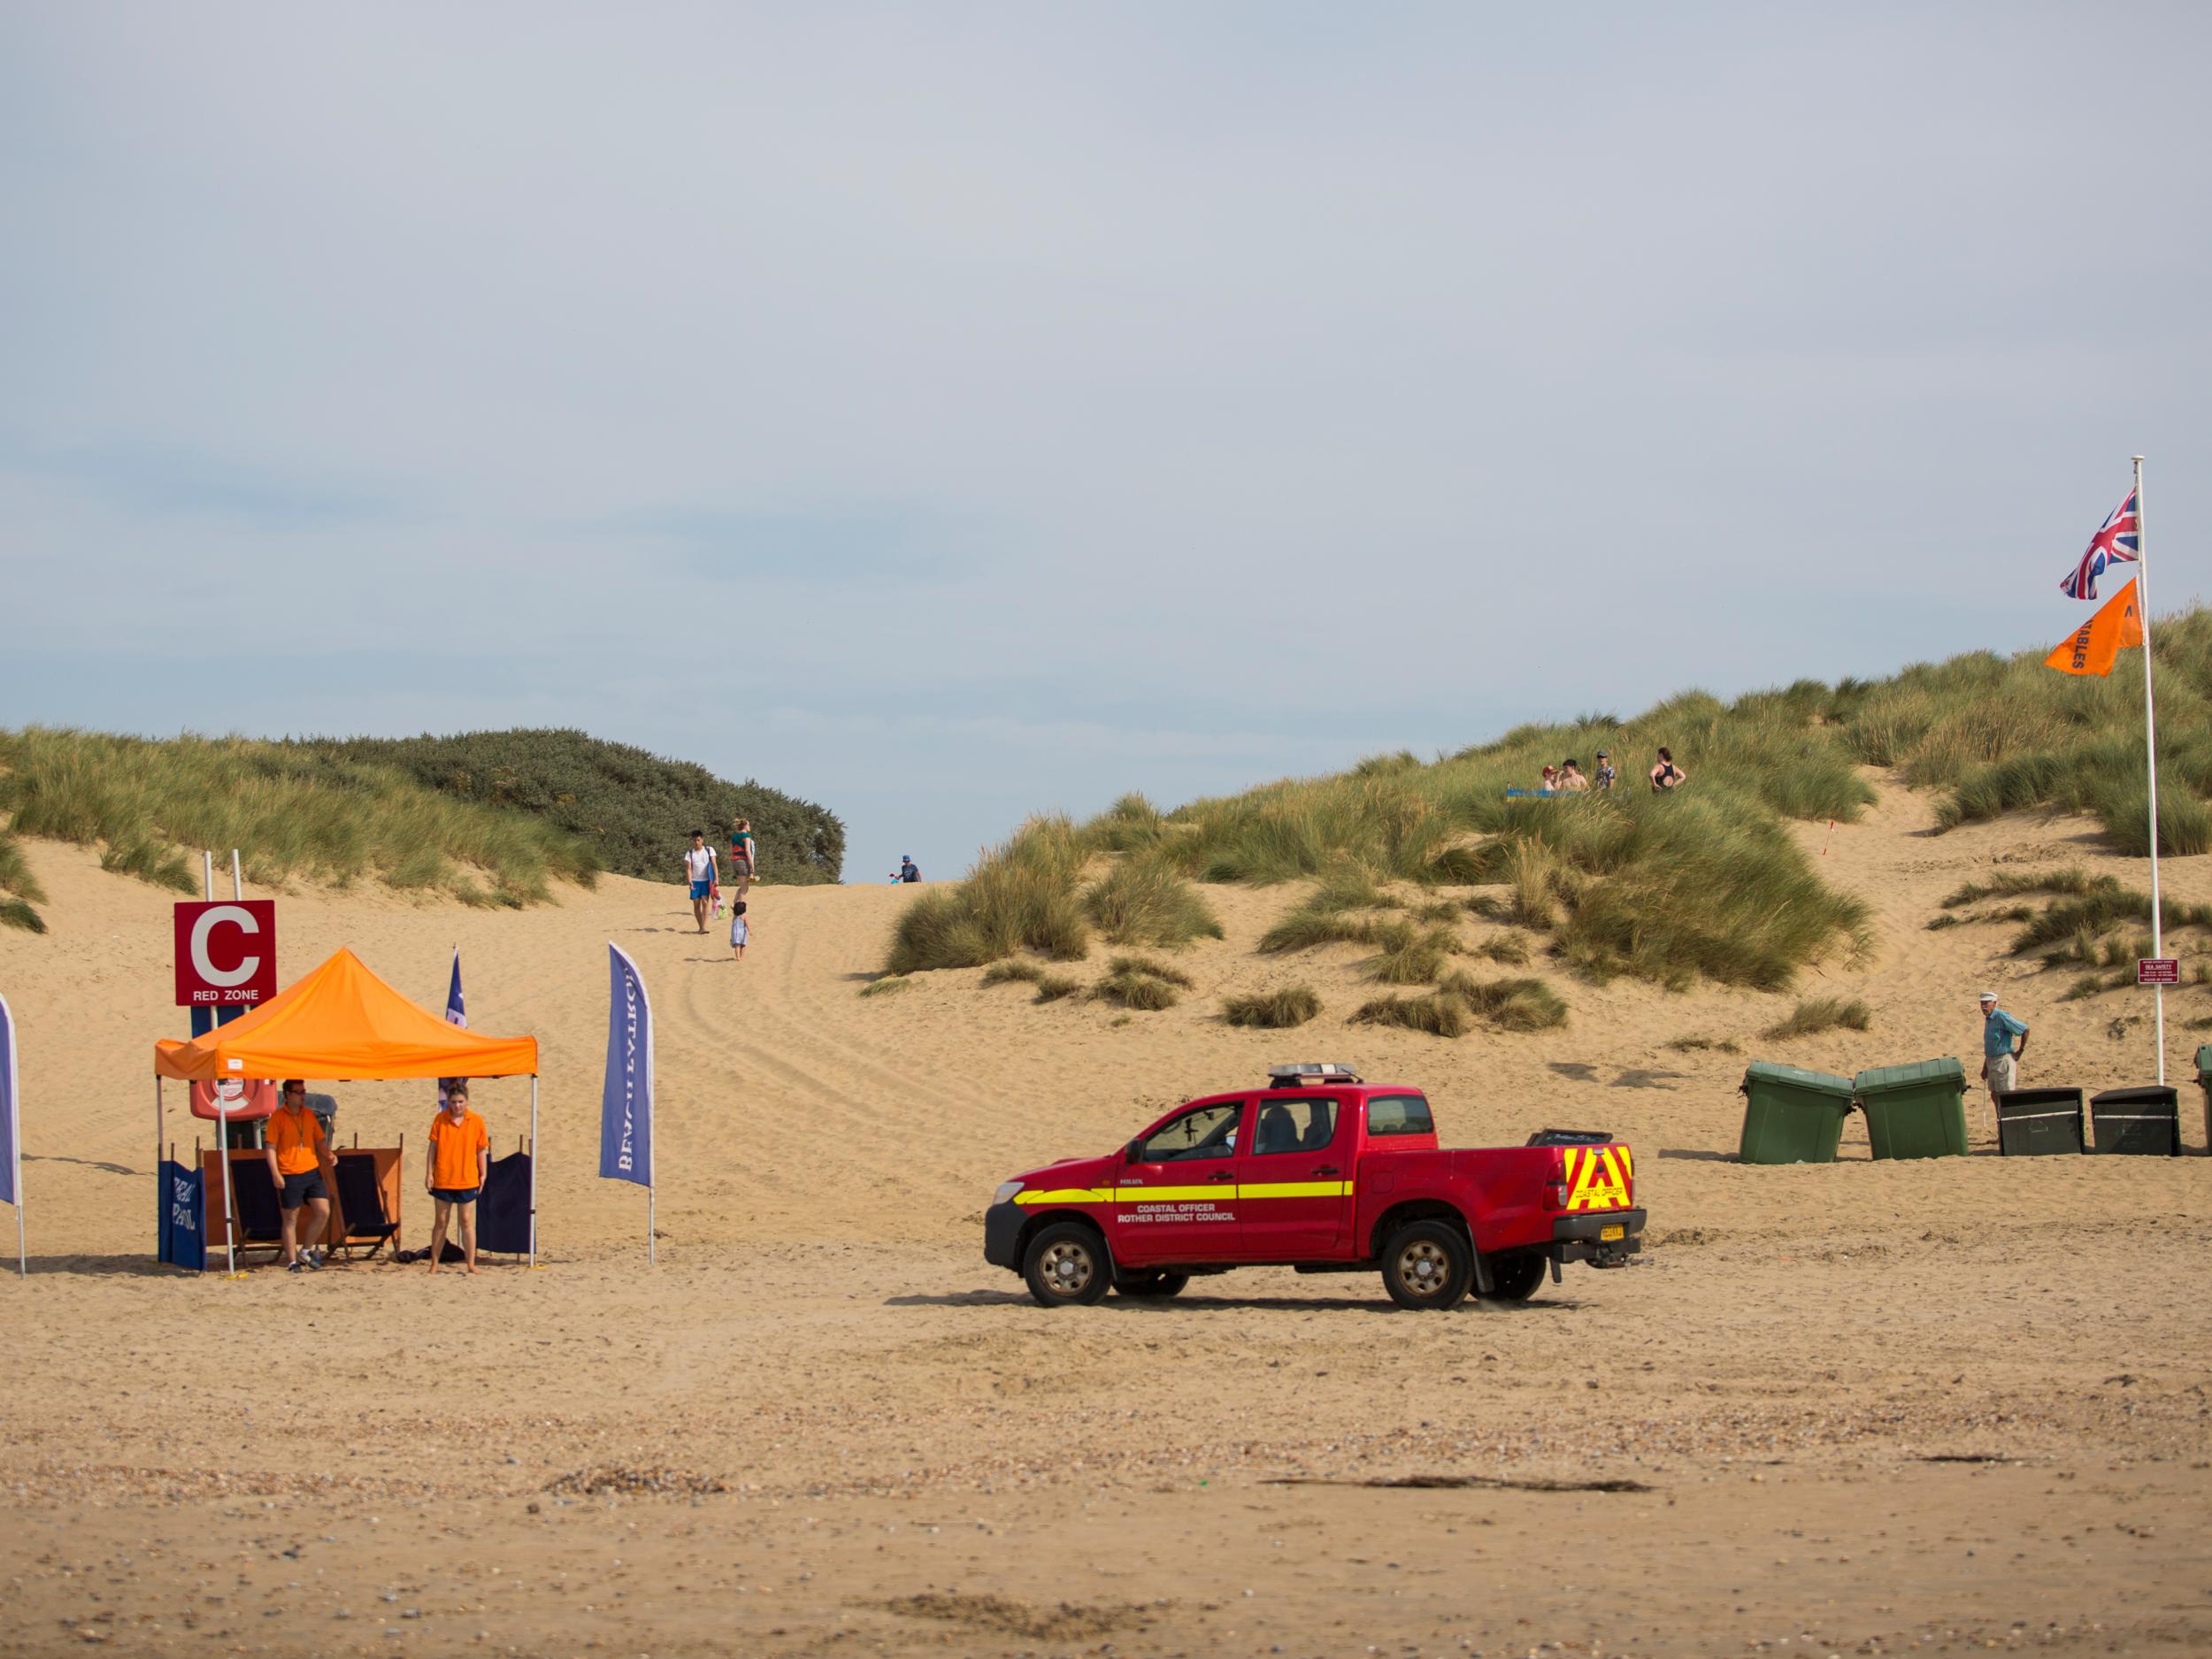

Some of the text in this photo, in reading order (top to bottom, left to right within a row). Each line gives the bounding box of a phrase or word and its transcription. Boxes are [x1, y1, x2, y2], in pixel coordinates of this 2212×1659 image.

[190, 905, 260, 987] C
[193, 989, 259, 1002] RED ZONE
[1137, 1203, 1216, 1213] COASTAL OFFICER
[1118, 1212, 1236, 1223] ROTHER DISTRICT COUNCIL
